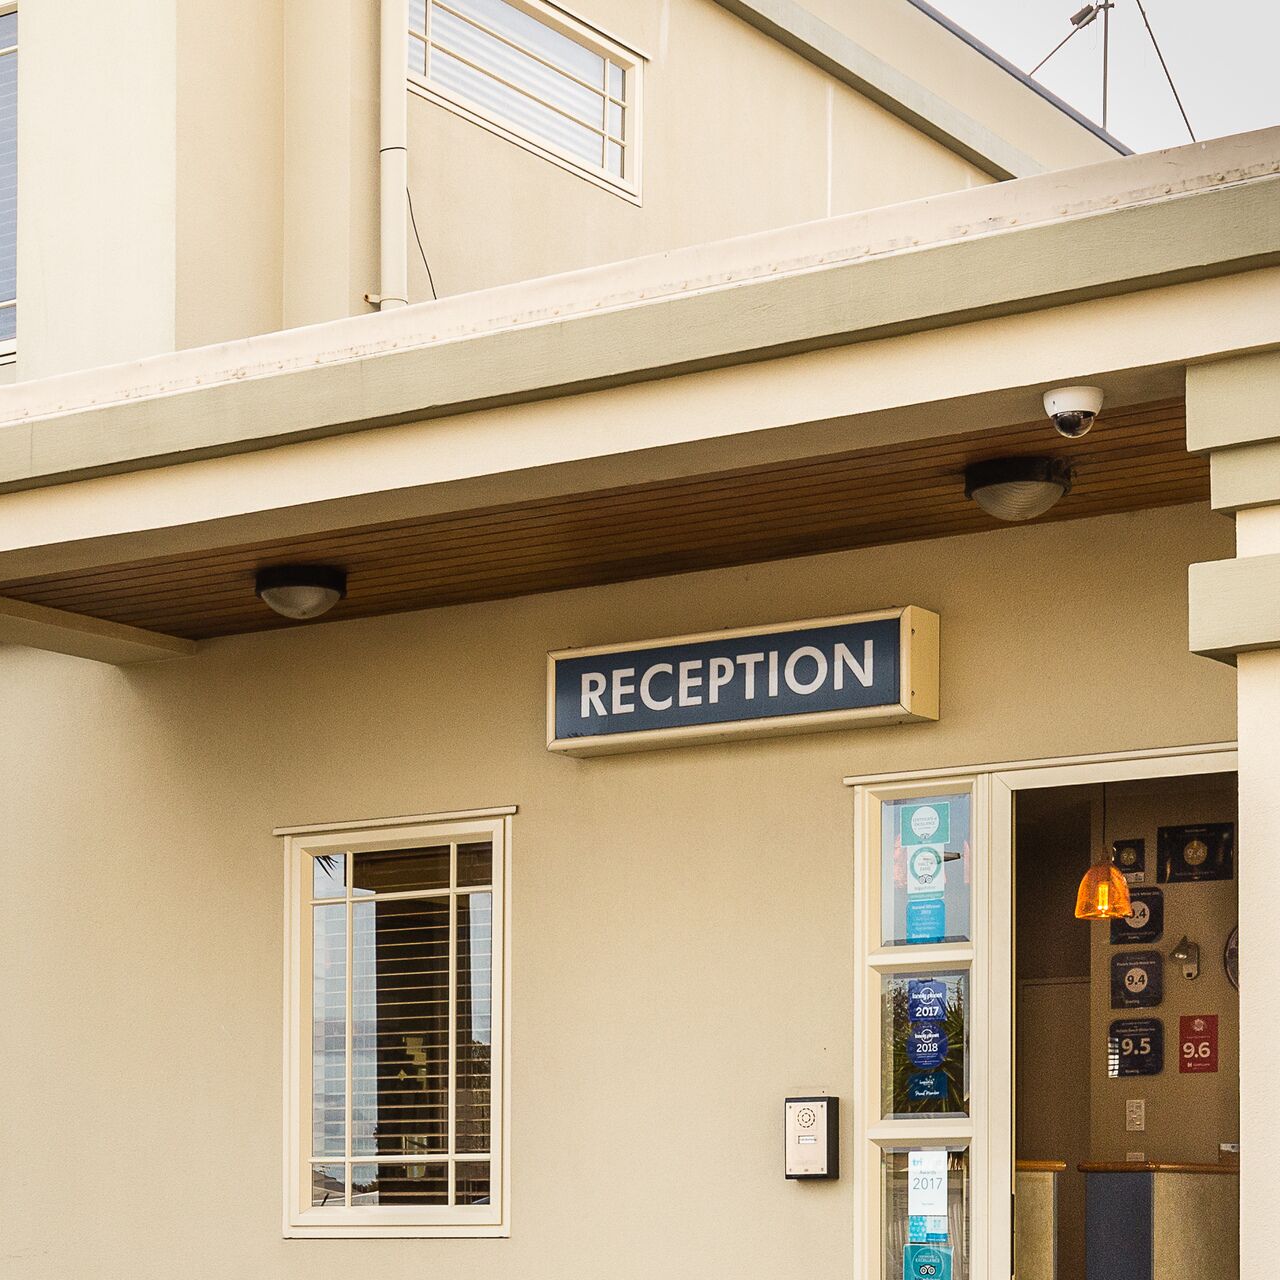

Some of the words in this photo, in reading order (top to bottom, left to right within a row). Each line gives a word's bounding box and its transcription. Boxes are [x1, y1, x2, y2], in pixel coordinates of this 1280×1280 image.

[581, 639, 874, 719] RECEPTION
[1127, 974, 1146, 986] 9.4
[915, 1006, 939, 1017] 2017
[916, 1042, 939, 1053] 2018
[1121, 1037, 1152, 1056] 9.5
[1182, 1041, 1211, 1059] 9.6
[913, 1177, 943, 1190] 2017
